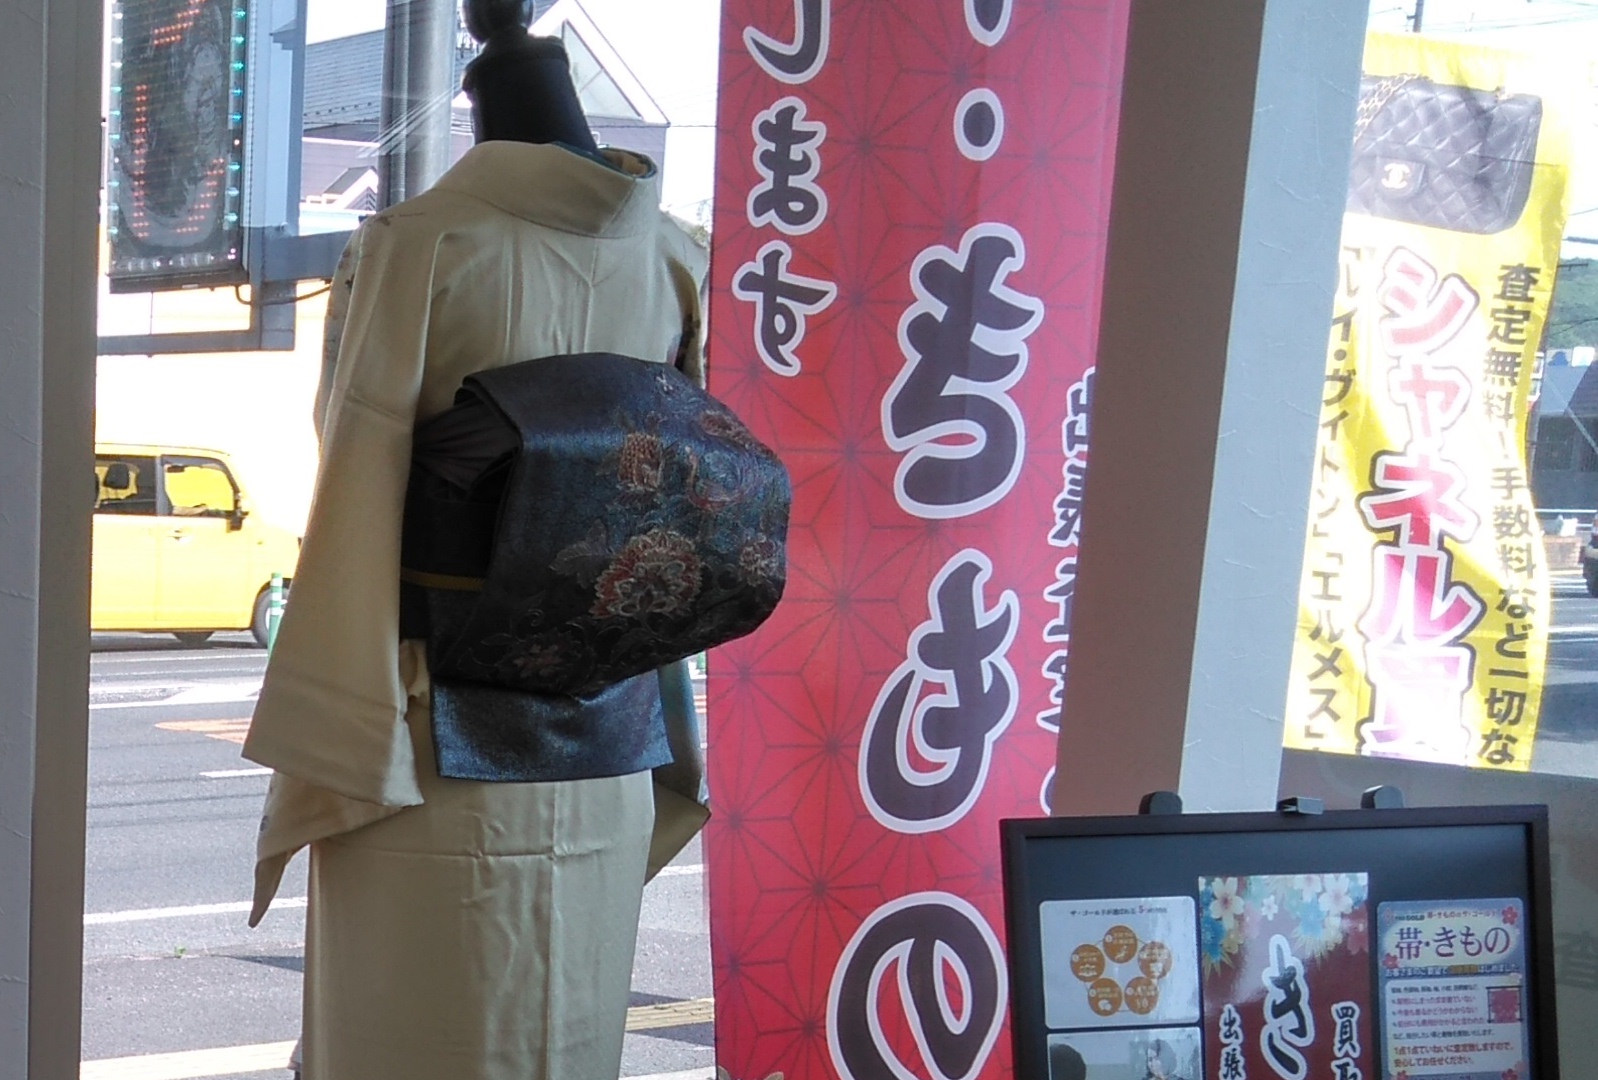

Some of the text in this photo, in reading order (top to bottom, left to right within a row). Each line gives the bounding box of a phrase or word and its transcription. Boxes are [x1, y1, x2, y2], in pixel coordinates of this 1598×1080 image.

[1360, 245, 1487, 758] シャネル買
[1394, 925, 1511, 960] 帯・きもの
